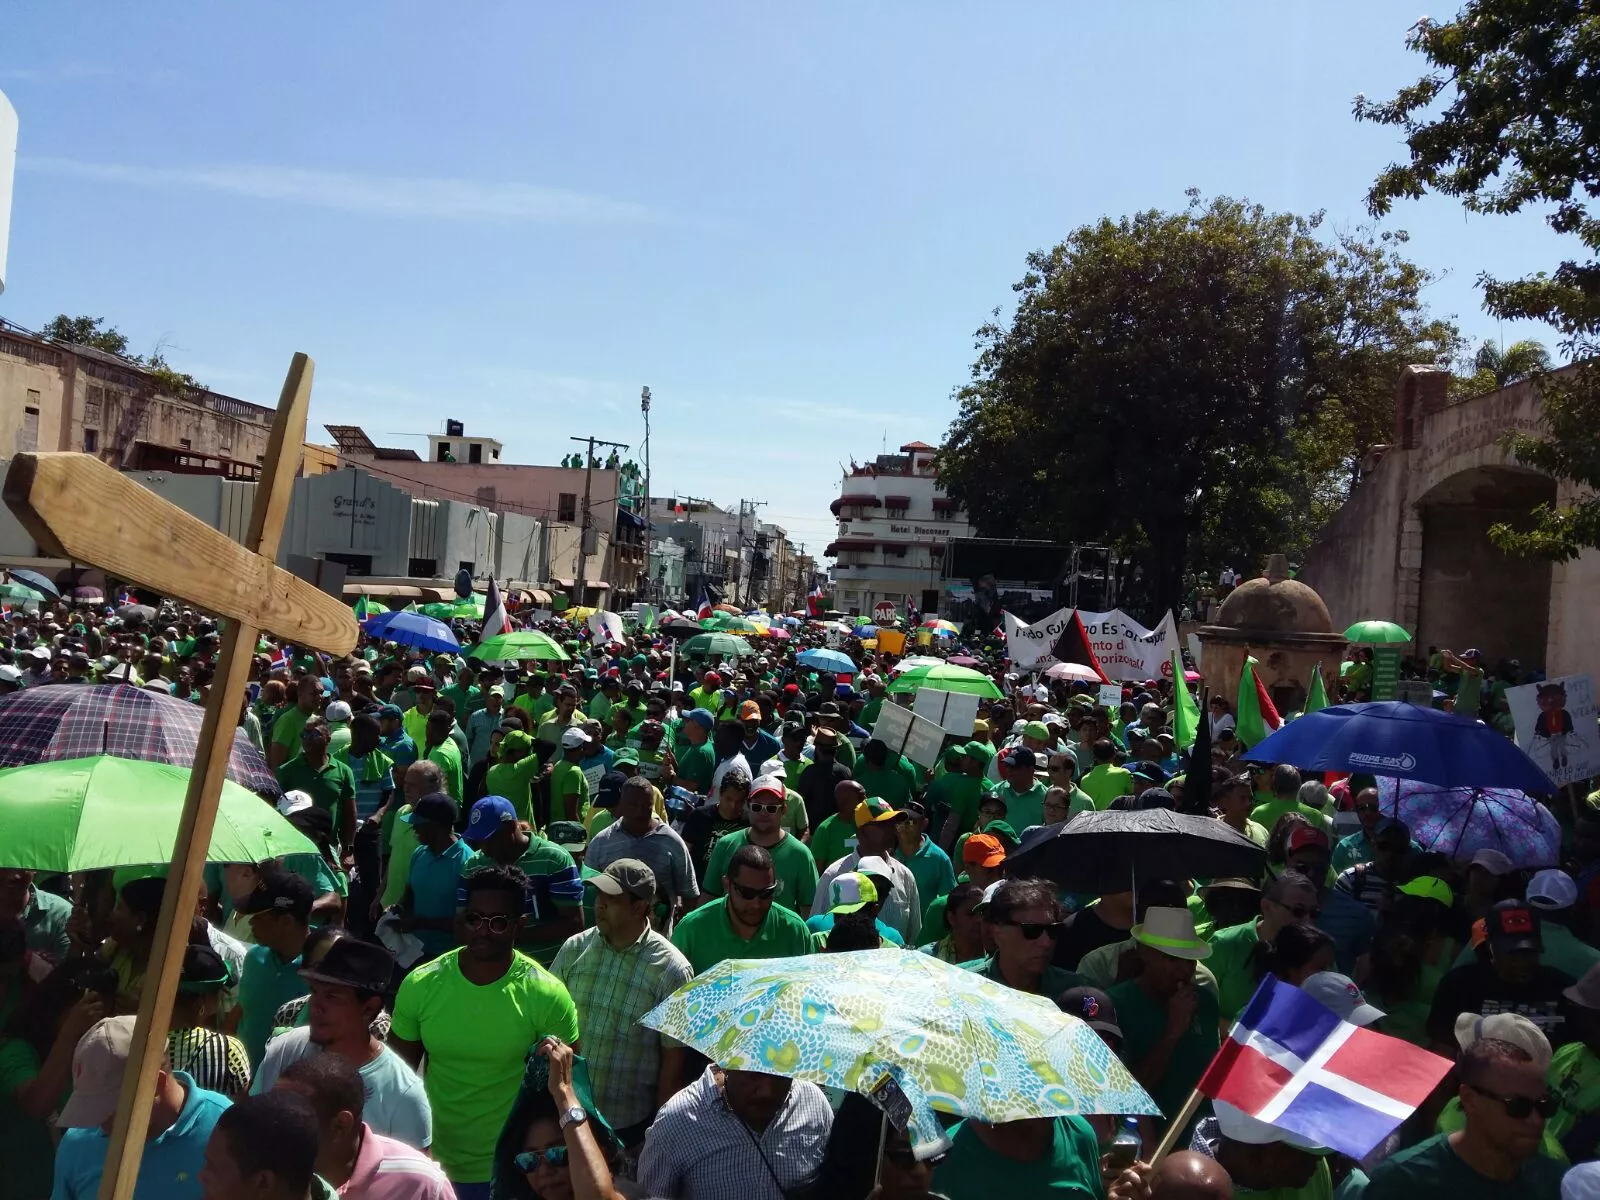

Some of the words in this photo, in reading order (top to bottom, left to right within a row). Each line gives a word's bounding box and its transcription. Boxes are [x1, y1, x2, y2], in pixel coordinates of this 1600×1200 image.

[891, 524, 910, 533] Hotel
[914, 526, 950, 536] Discovery
[874, 608, 897, 621] PARE
[1102, 622, 1118, 635] Es
